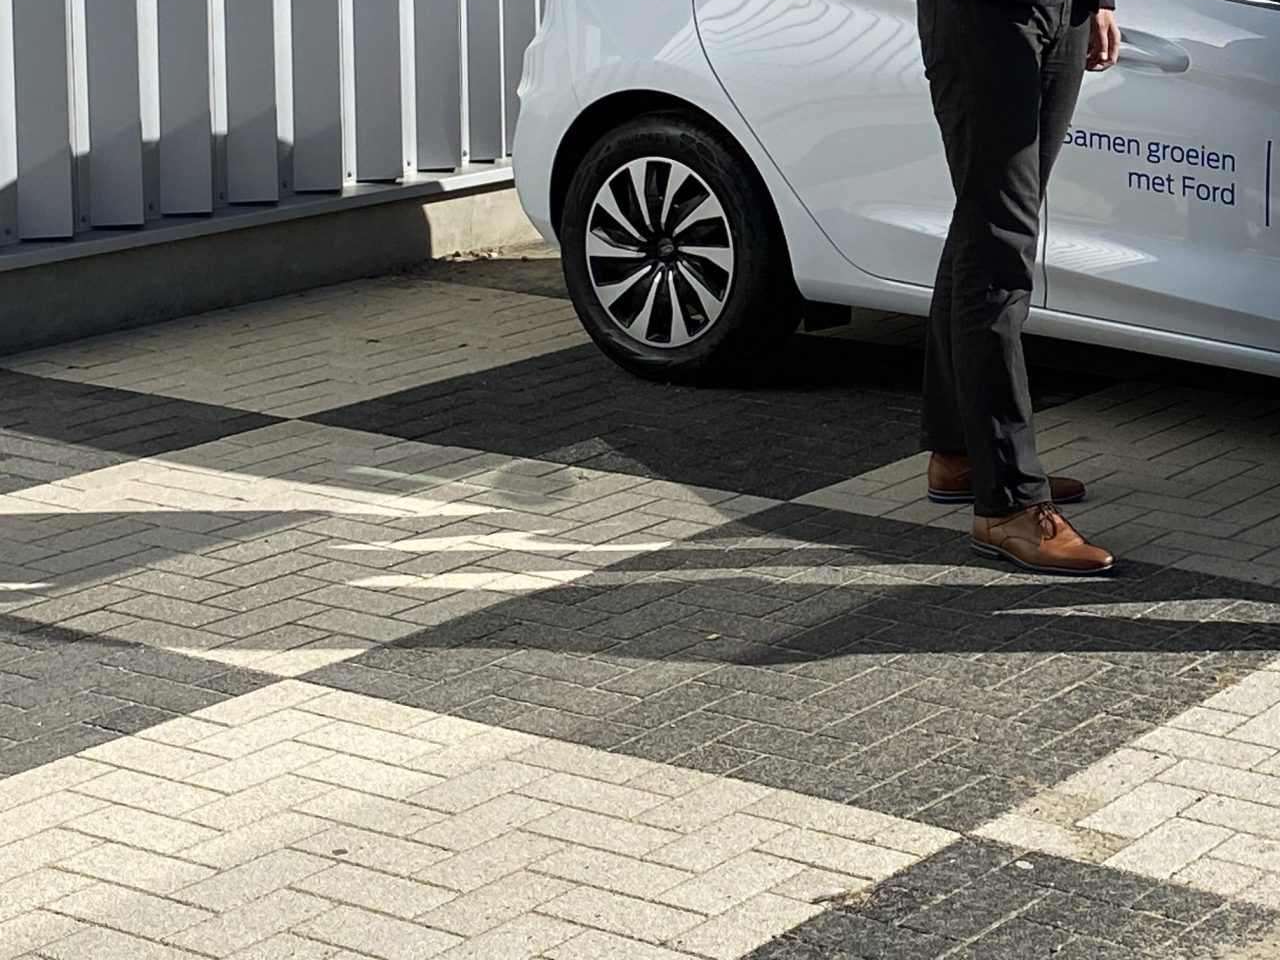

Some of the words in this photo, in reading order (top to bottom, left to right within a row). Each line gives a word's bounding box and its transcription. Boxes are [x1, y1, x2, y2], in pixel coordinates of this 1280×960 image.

[1146, 141, 1236, 172] groeien
[1128, 171, 1175, 195] met
[1182, 175, 1236, 206] Ford
